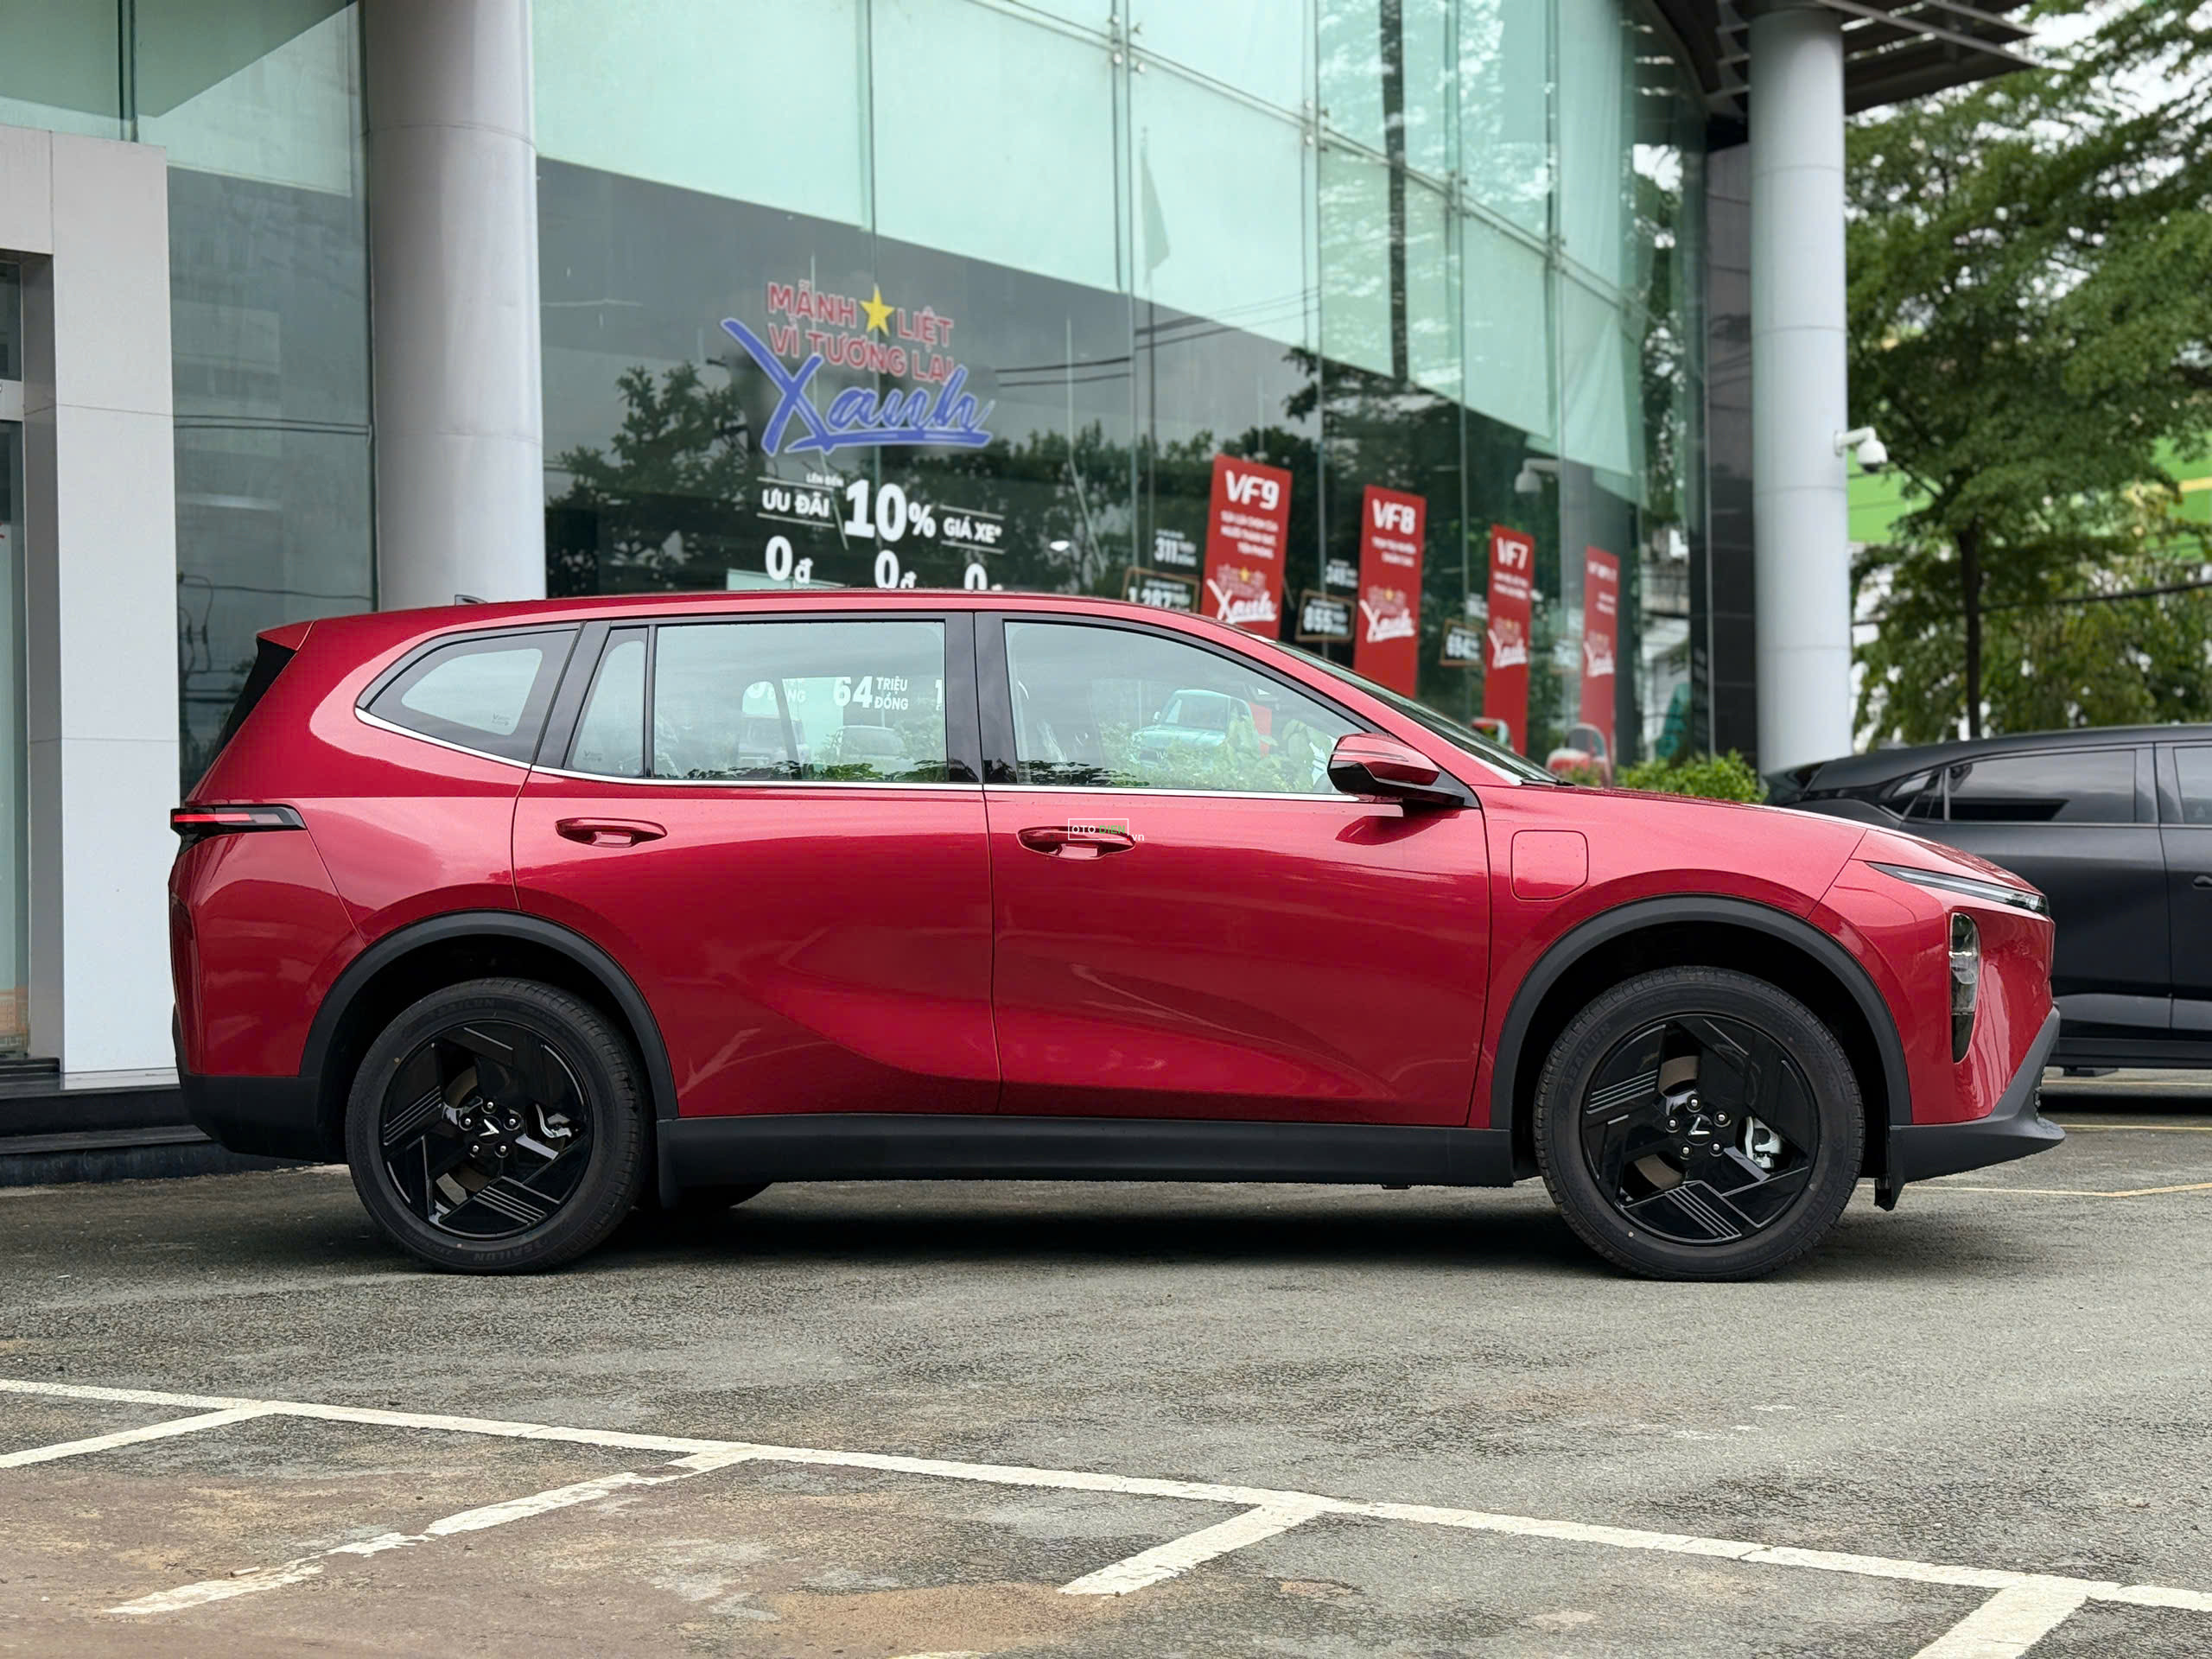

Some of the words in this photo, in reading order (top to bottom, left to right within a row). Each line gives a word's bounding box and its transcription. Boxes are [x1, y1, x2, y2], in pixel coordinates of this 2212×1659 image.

[768, 278, 858, 329] MÃNH
[897, 305, 954, 353] LIỆT
[805, 331, 906, 378] TƯƠNG
[721, 318, 996, 456] Xanh
[762, 487, 791, 512] ƯU
[794, 491, 830, 518] ĐÃI
[845, 479, 937, 542] 10%
[943, 516, 973, 540] GIÁ
[1225, 469, 1280, 511] VF9
[1372, 499, 1416, 535] VF8
[833, 676, 873, 709] 64
[876, 676, 908, 695] TRIỆU
